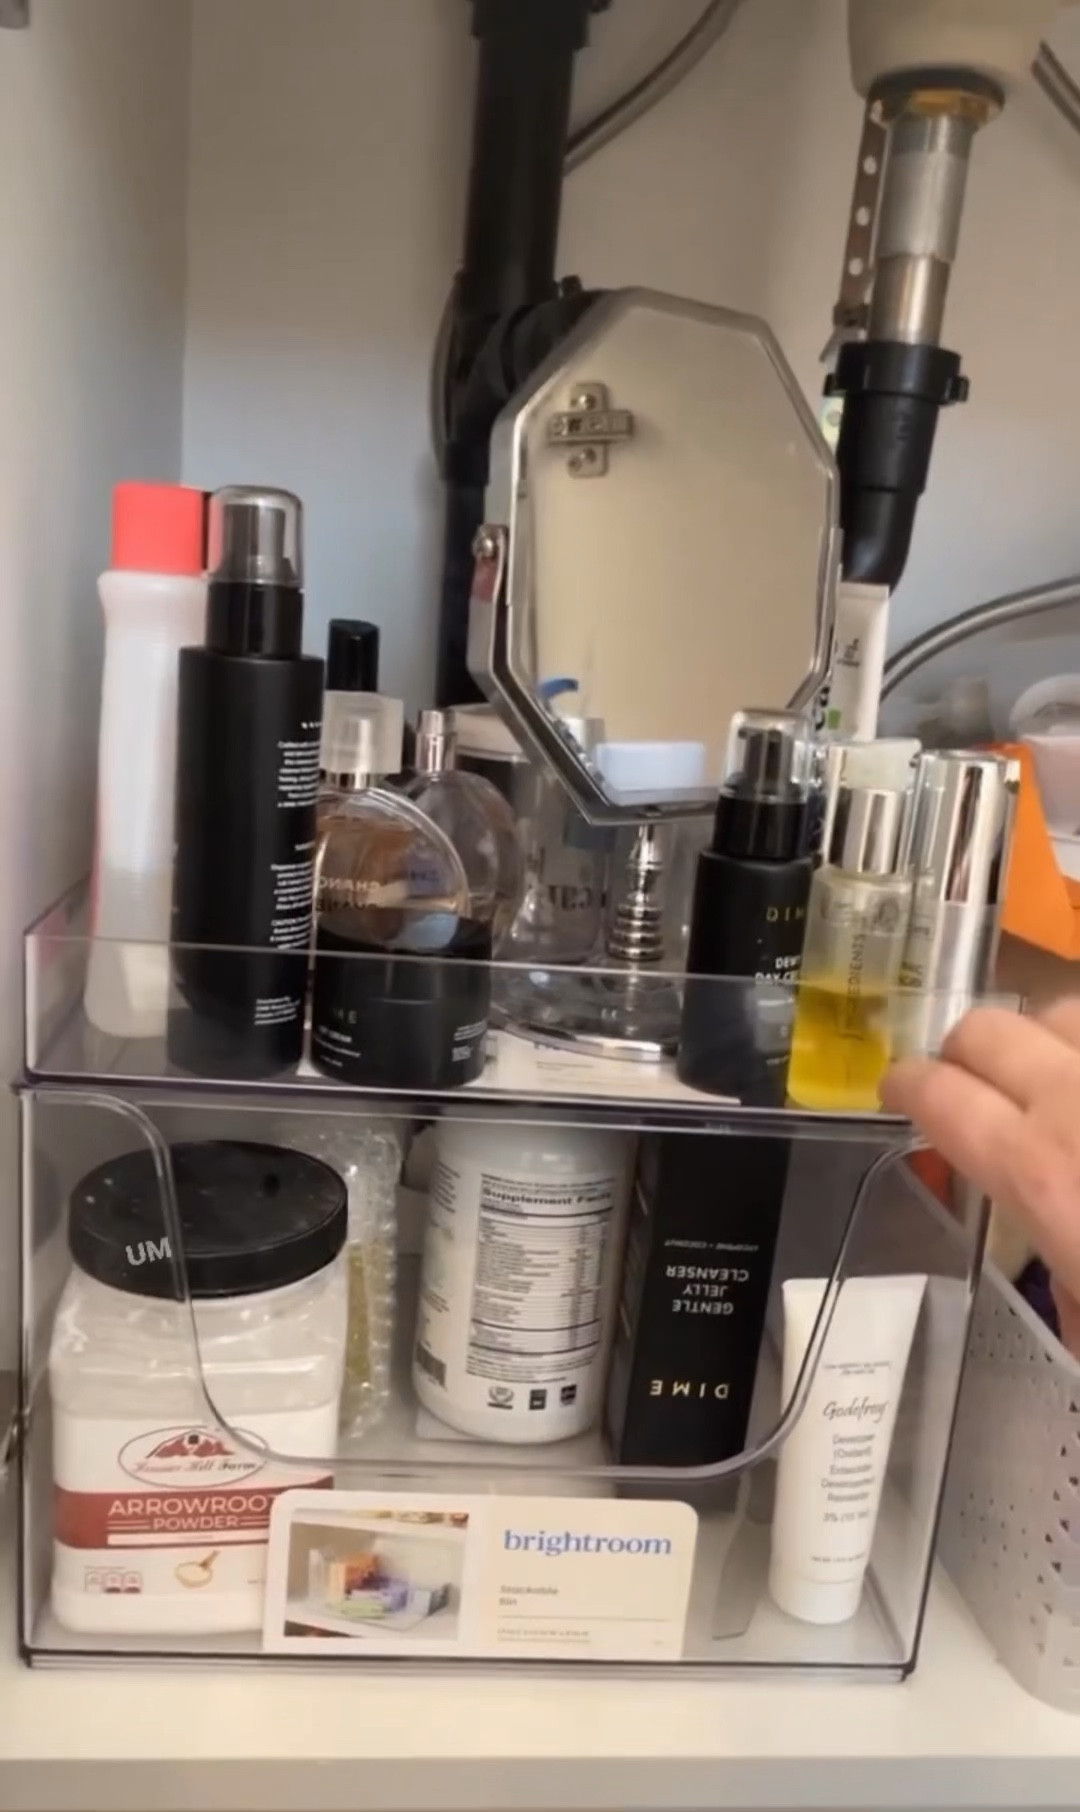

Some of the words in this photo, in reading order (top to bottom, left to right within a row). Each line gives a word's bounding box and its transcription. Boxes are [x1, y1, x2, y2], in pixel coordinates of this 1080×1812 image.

[665, 1265, 750, 1282] CLEANSER
[682, 1284, 729, 1297] JELLY
[671, 1299, 734, 1315] GENTLE
[650, 1379, 729, 1399] DIME
[153, 1516, 239, 1530] POWDER
[504, 1529, 672, 1556] brightroom
